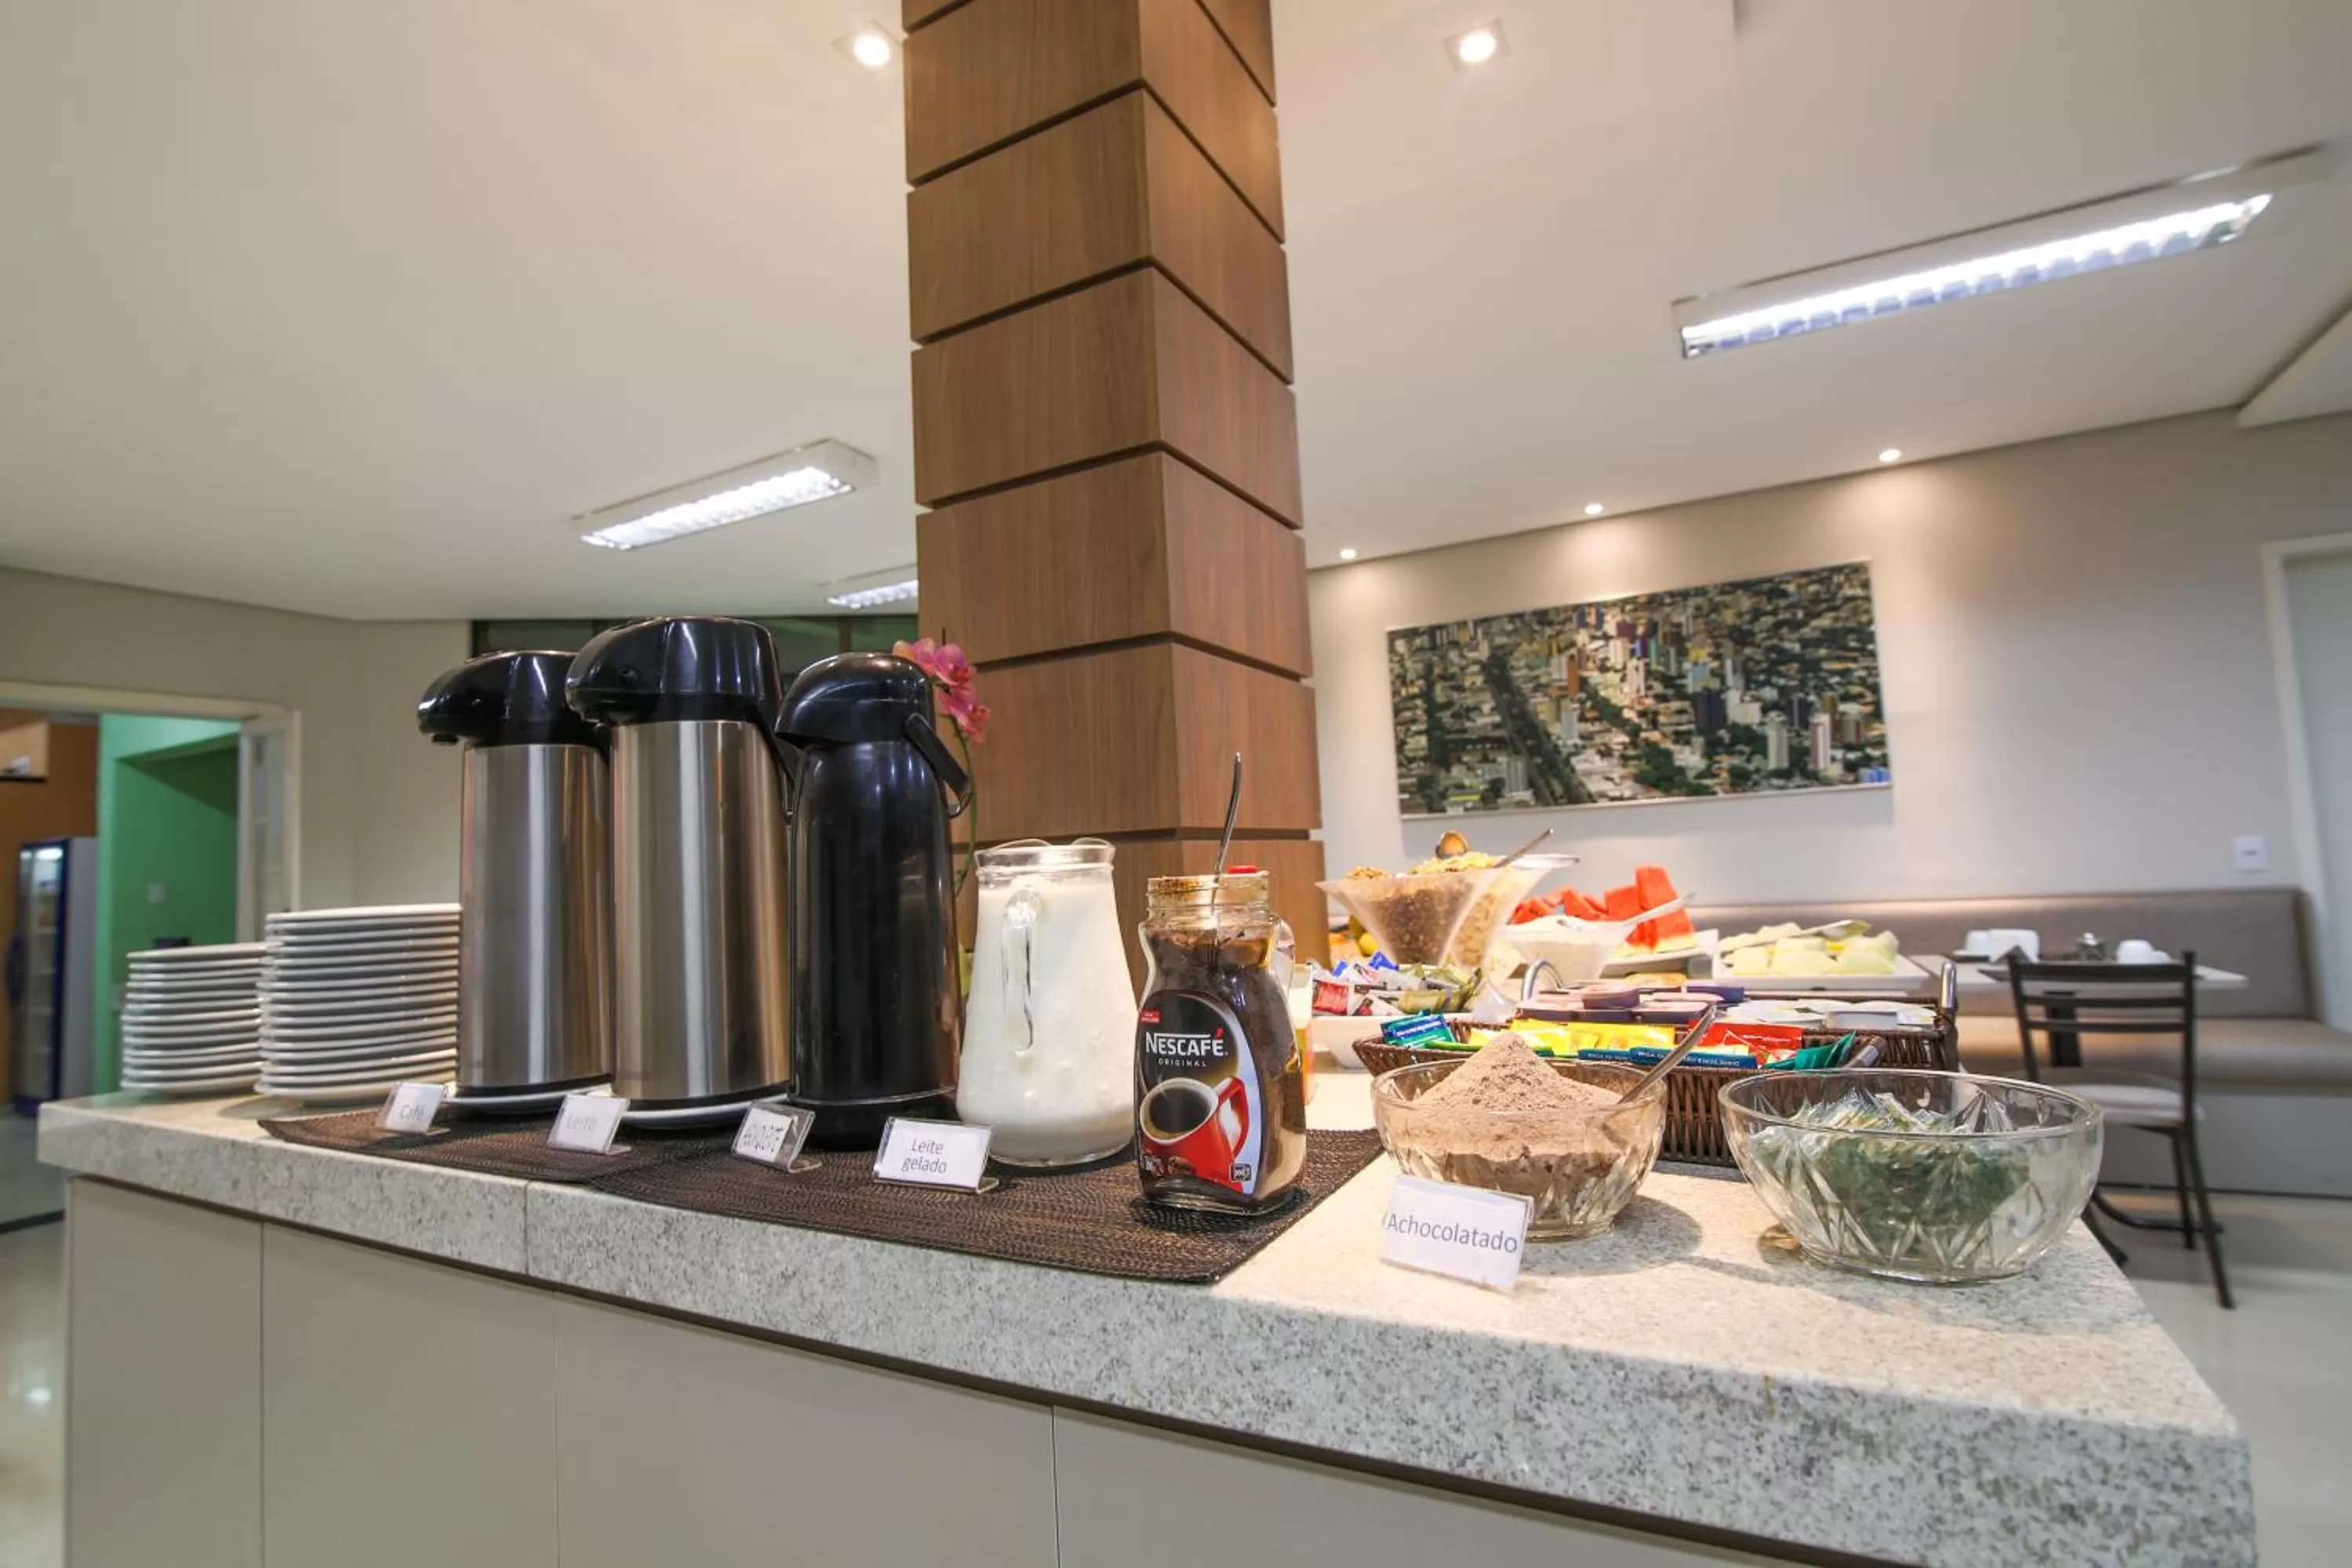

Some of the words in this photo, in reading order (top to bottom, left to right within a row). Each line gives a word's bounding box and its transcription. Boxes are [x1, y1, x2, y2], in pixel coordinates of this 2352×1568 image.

[1145, 1028, 1225, 1056] NESCAFÉ
[1158, 1057, 1207, 1067] ORIGINAL
[911, 1138, 944, 1155] Leite
[901, 1156, 947, 1174] gelado
[1387, 1213, 1518, 1254] Achocolatado
